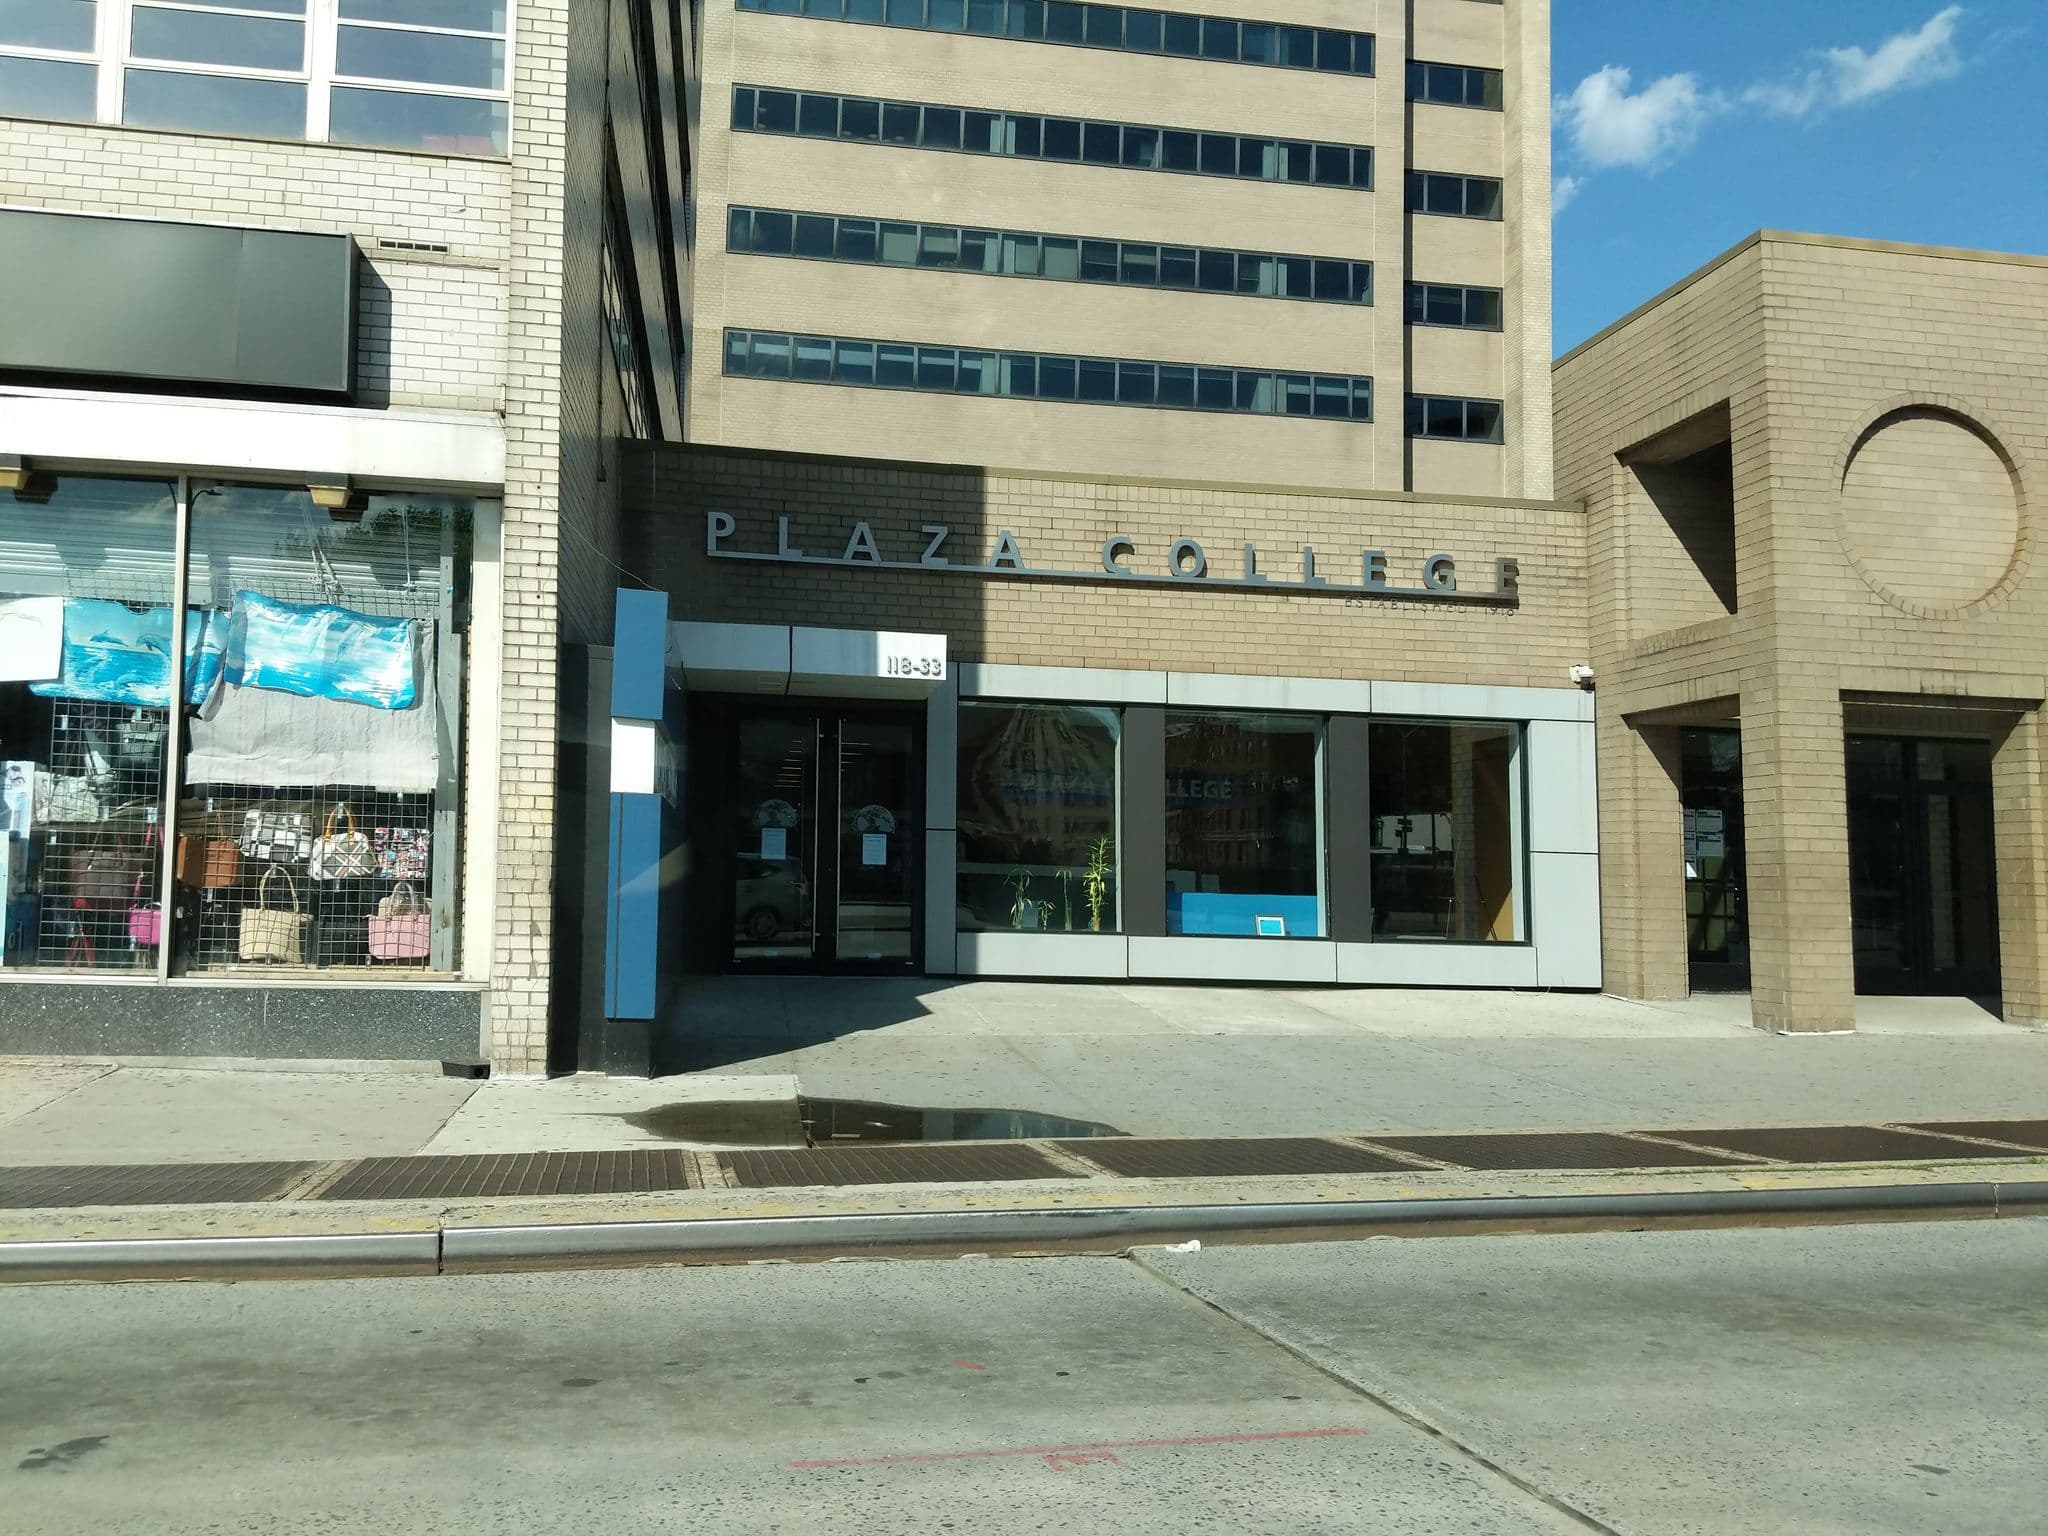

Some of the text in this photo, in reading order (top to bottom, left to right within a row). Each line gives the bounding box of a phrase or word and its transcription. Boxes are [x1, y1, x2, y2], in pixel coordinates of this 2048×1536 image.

[707, 511, 1519, 596] PLAZA COLLEGE
[1345, 596, 1467, 614] ESTABLISHED
[887, 656, 942, 676] 118-33
[1165, 778, 1232, 800] LLEGE
